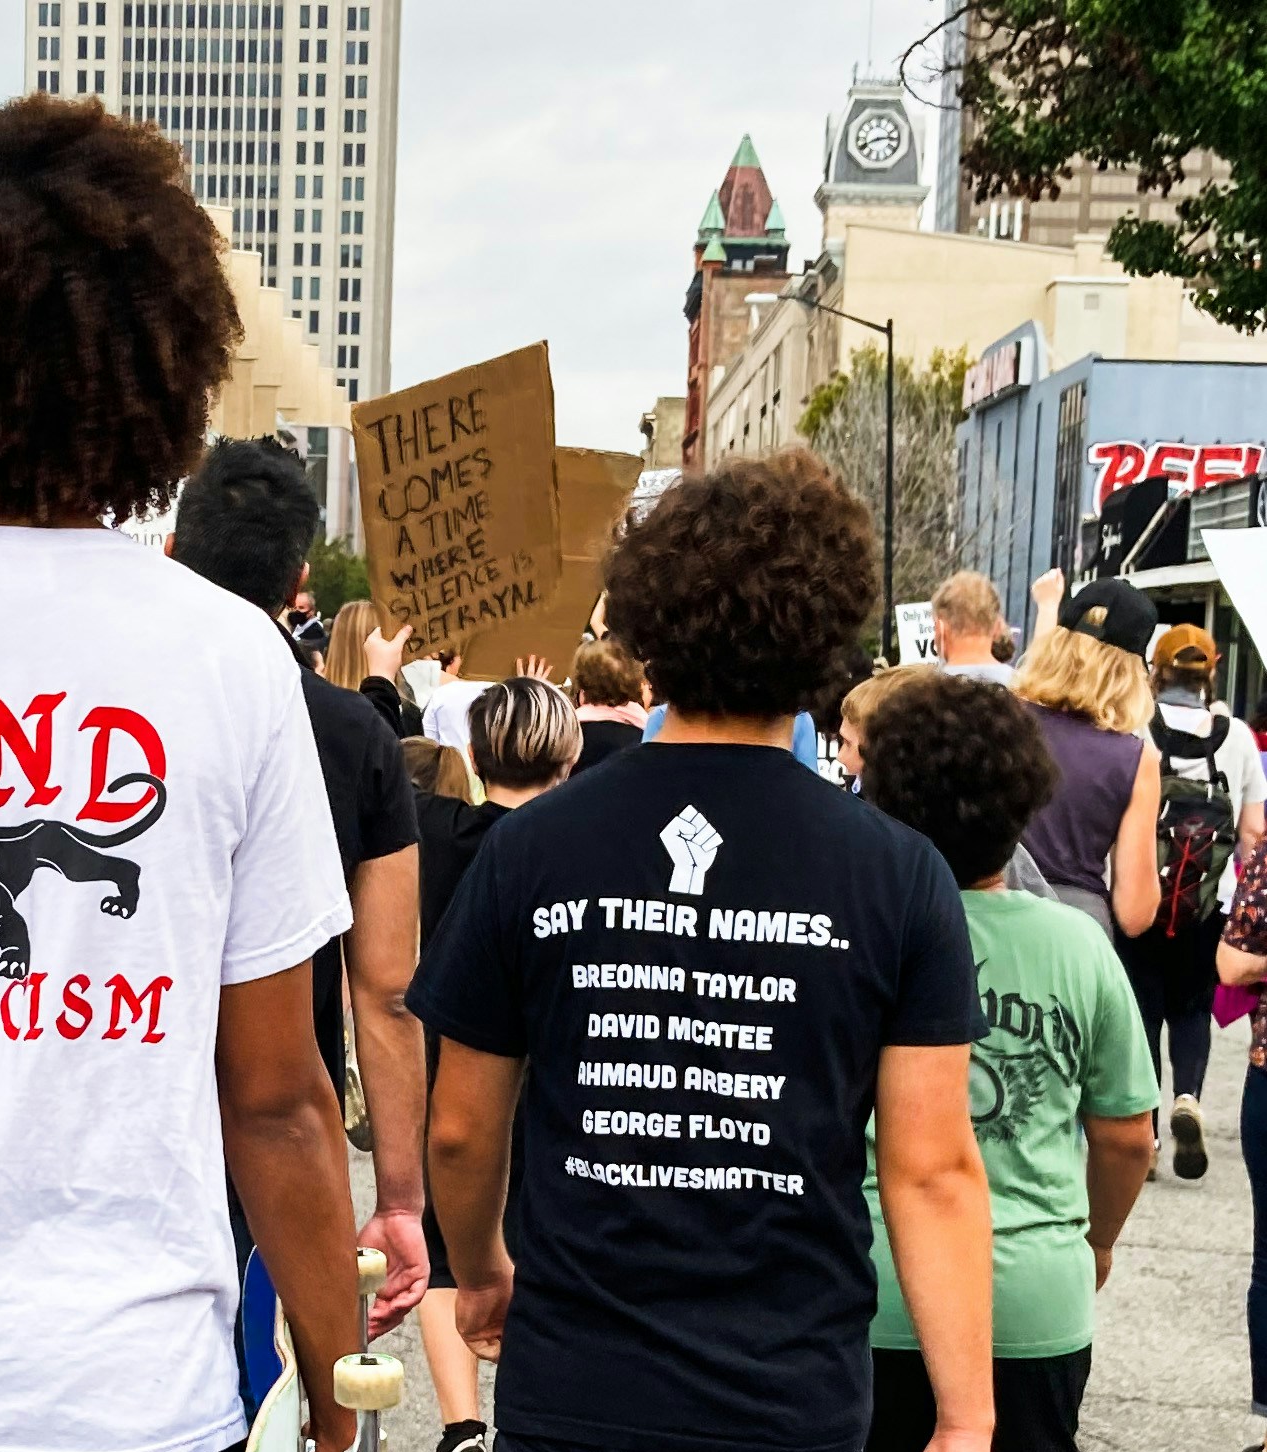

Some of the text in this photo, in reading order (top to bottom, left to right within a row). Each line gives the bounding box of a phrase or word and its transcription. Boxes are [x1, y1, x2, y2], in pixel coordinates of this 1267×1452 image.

[365, 388, 488, 475] THERE
[378, 447, 494, 521] COMES
[397, 490, 490, 557] A TIME
[390, 528, 486, 589] WHERE
[406, 580, 541, 653] BETRAYAL
[532, 897, 850, 950] SAY THEIR NAMES..
[572, 963, 797, 1003] BREONNA TAYLOR
[587, 1012, 774, 1051] DAVID MCATEE
[577, 1061, 787, 1100] AHMAUD ARBERY
[582, 1109, 771, 1147] GEORGE FLOYD
[564, 1155, 805, 1196] #BLACKLIVESMATTER
